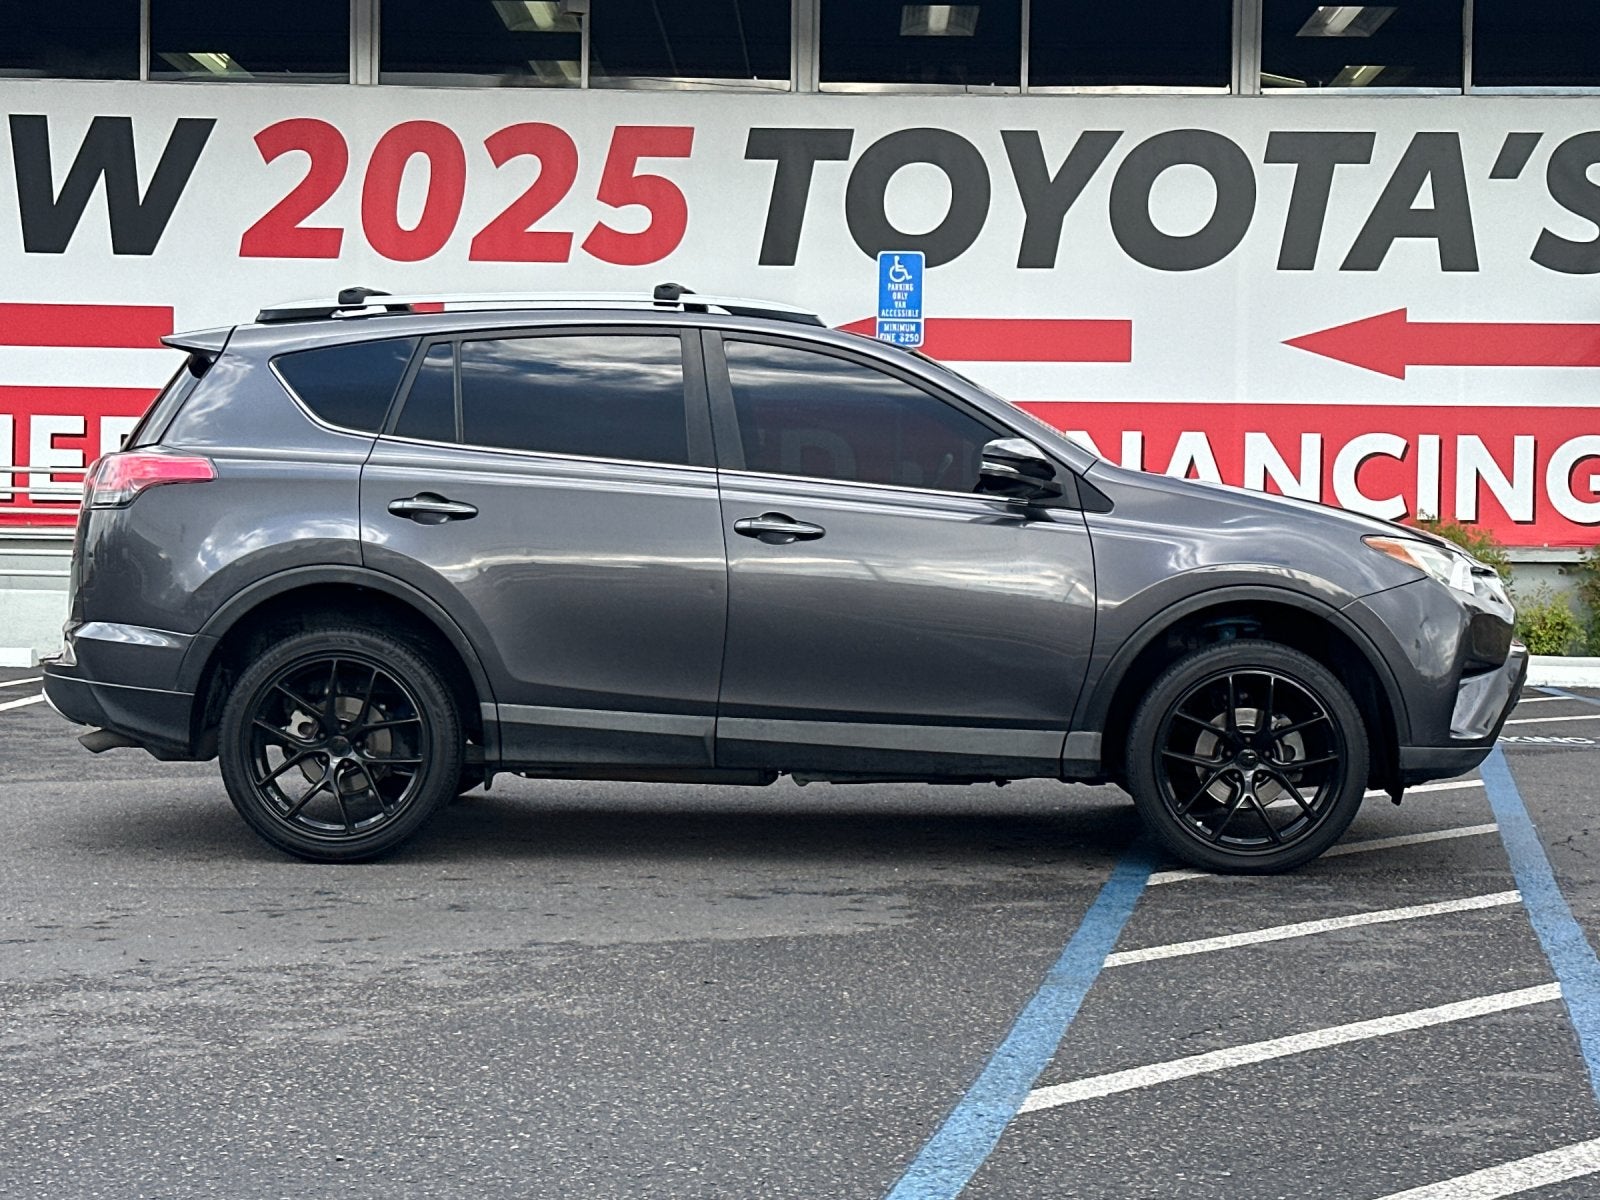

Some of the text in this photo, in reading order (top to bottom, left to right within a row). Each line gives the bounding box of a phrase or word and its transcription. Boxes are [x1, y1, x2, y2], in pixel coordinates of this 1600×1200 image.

[238, 117, 695, 266] 2025
[744, 127, 1600, 275] TOYOTA'S
[887, 283, 914, 291] PARKING
[892, 292, 908, 300] ONLY
[881, 309, 919, 317] ACCESSIBLE
[883, 323, 916, 332] MINIMUM
[880, 333, 919, 343] FINE $250
